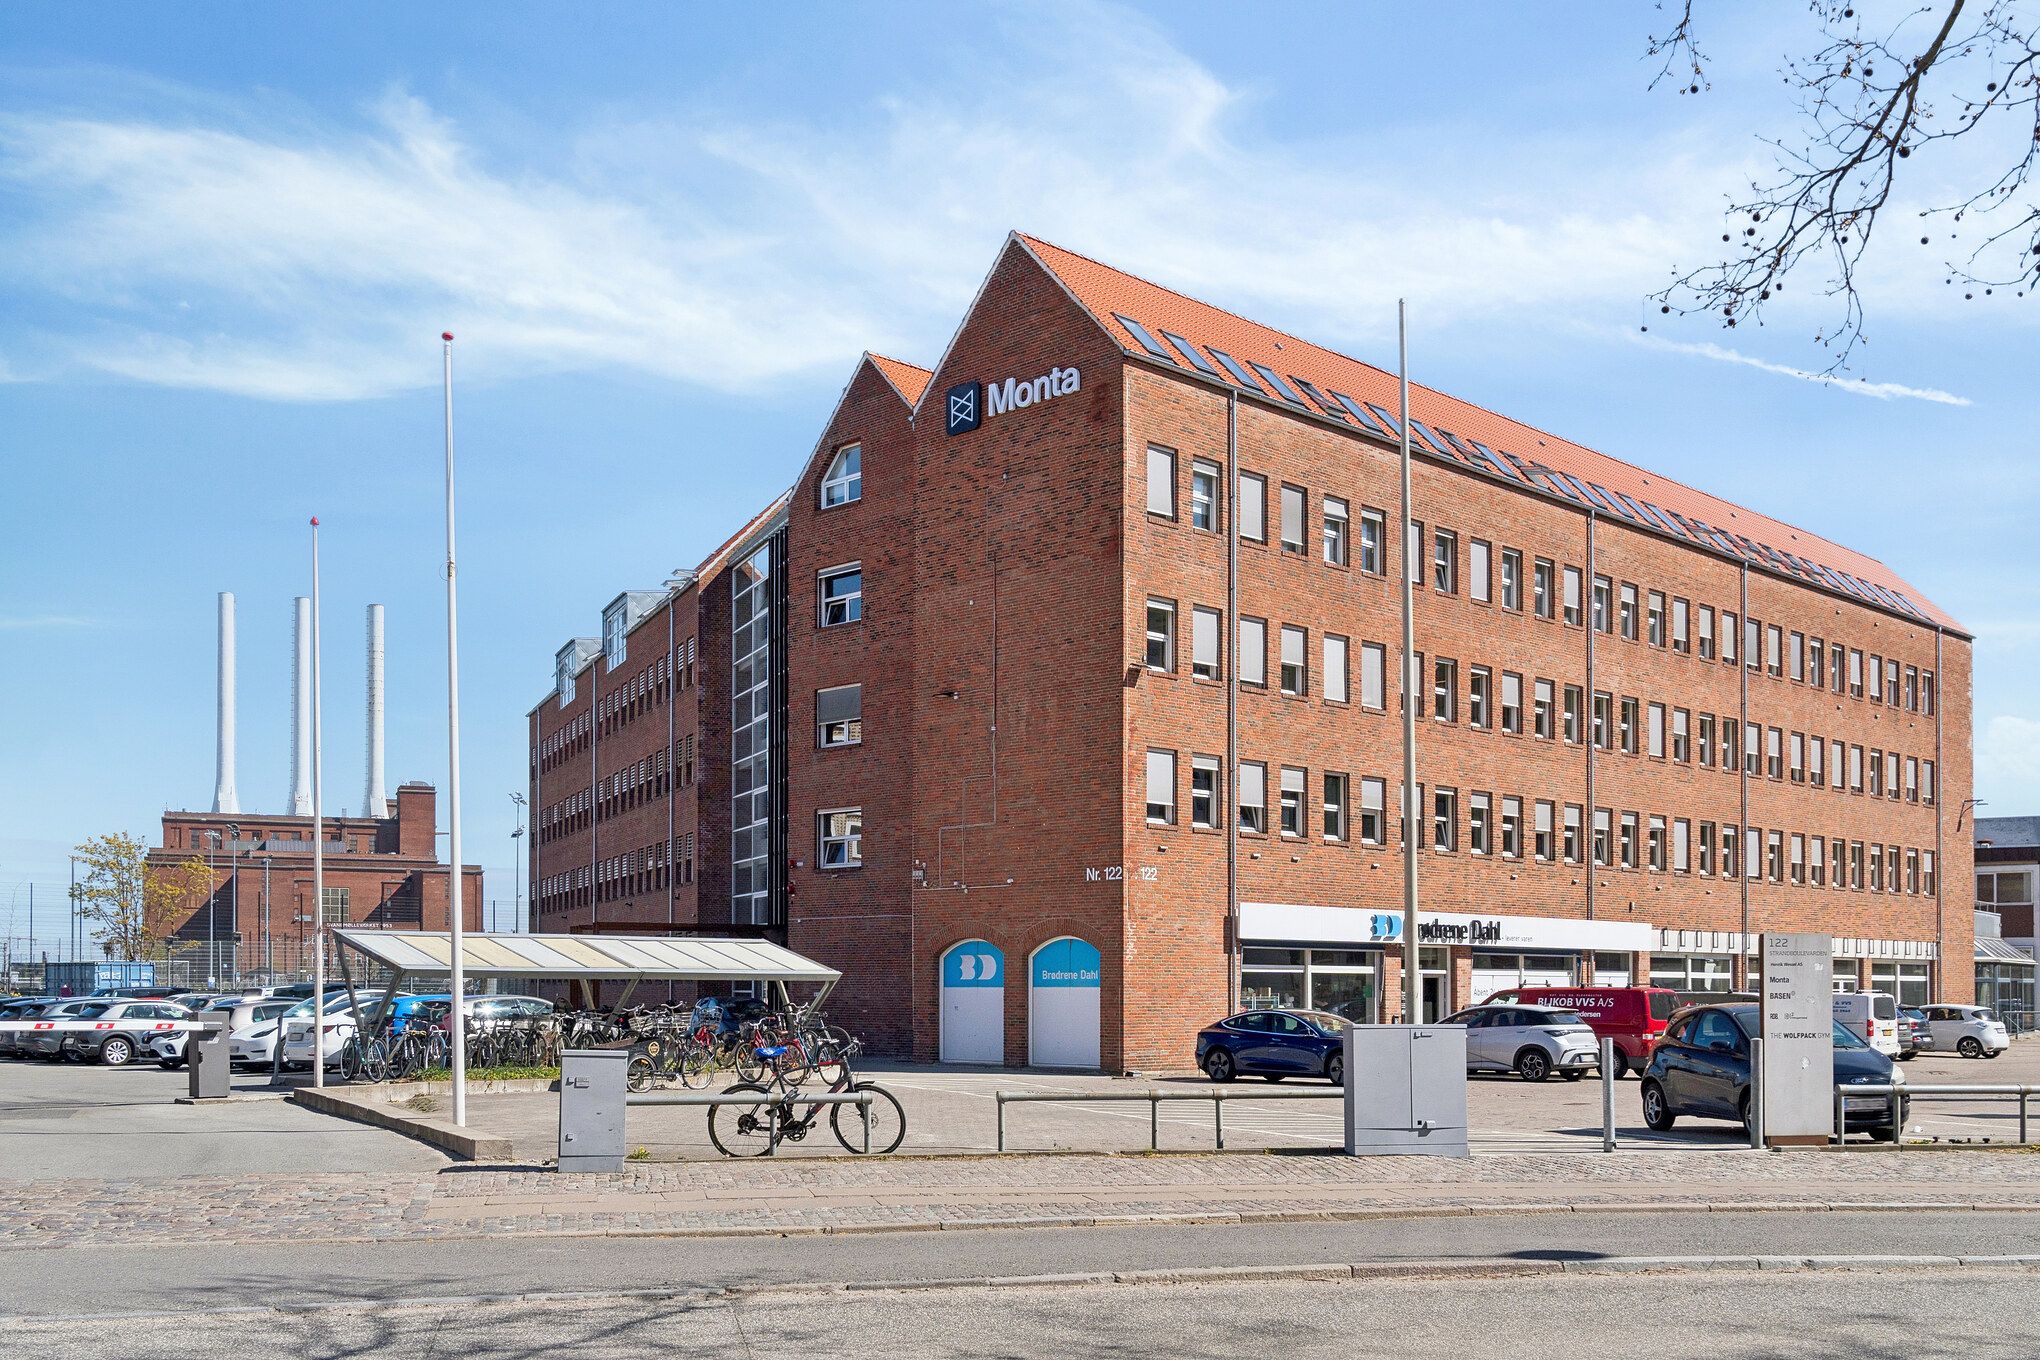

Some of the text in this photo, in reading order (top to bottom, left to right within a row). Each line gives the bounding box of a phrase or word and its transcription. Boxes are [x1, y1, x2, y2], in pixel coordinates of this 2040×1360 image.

[987, 366, 1081, 417] Monta
[1086, 866, 1123, 881] Nr. 122
[1140, 866, 1158, 881] 122
[1470, 919, 1501, 942] Dahl
[1769, 938, 1788, 948] 122
[1080, 969, 1099, 980] Dahl
[1769, 976, 1790, 984] Monta
[1575, 997, 1595, 1007] VVS
[1597, 997, 1614, 1008] A/S
[1783, 1032, 1817, 1040] WOLFPACK
